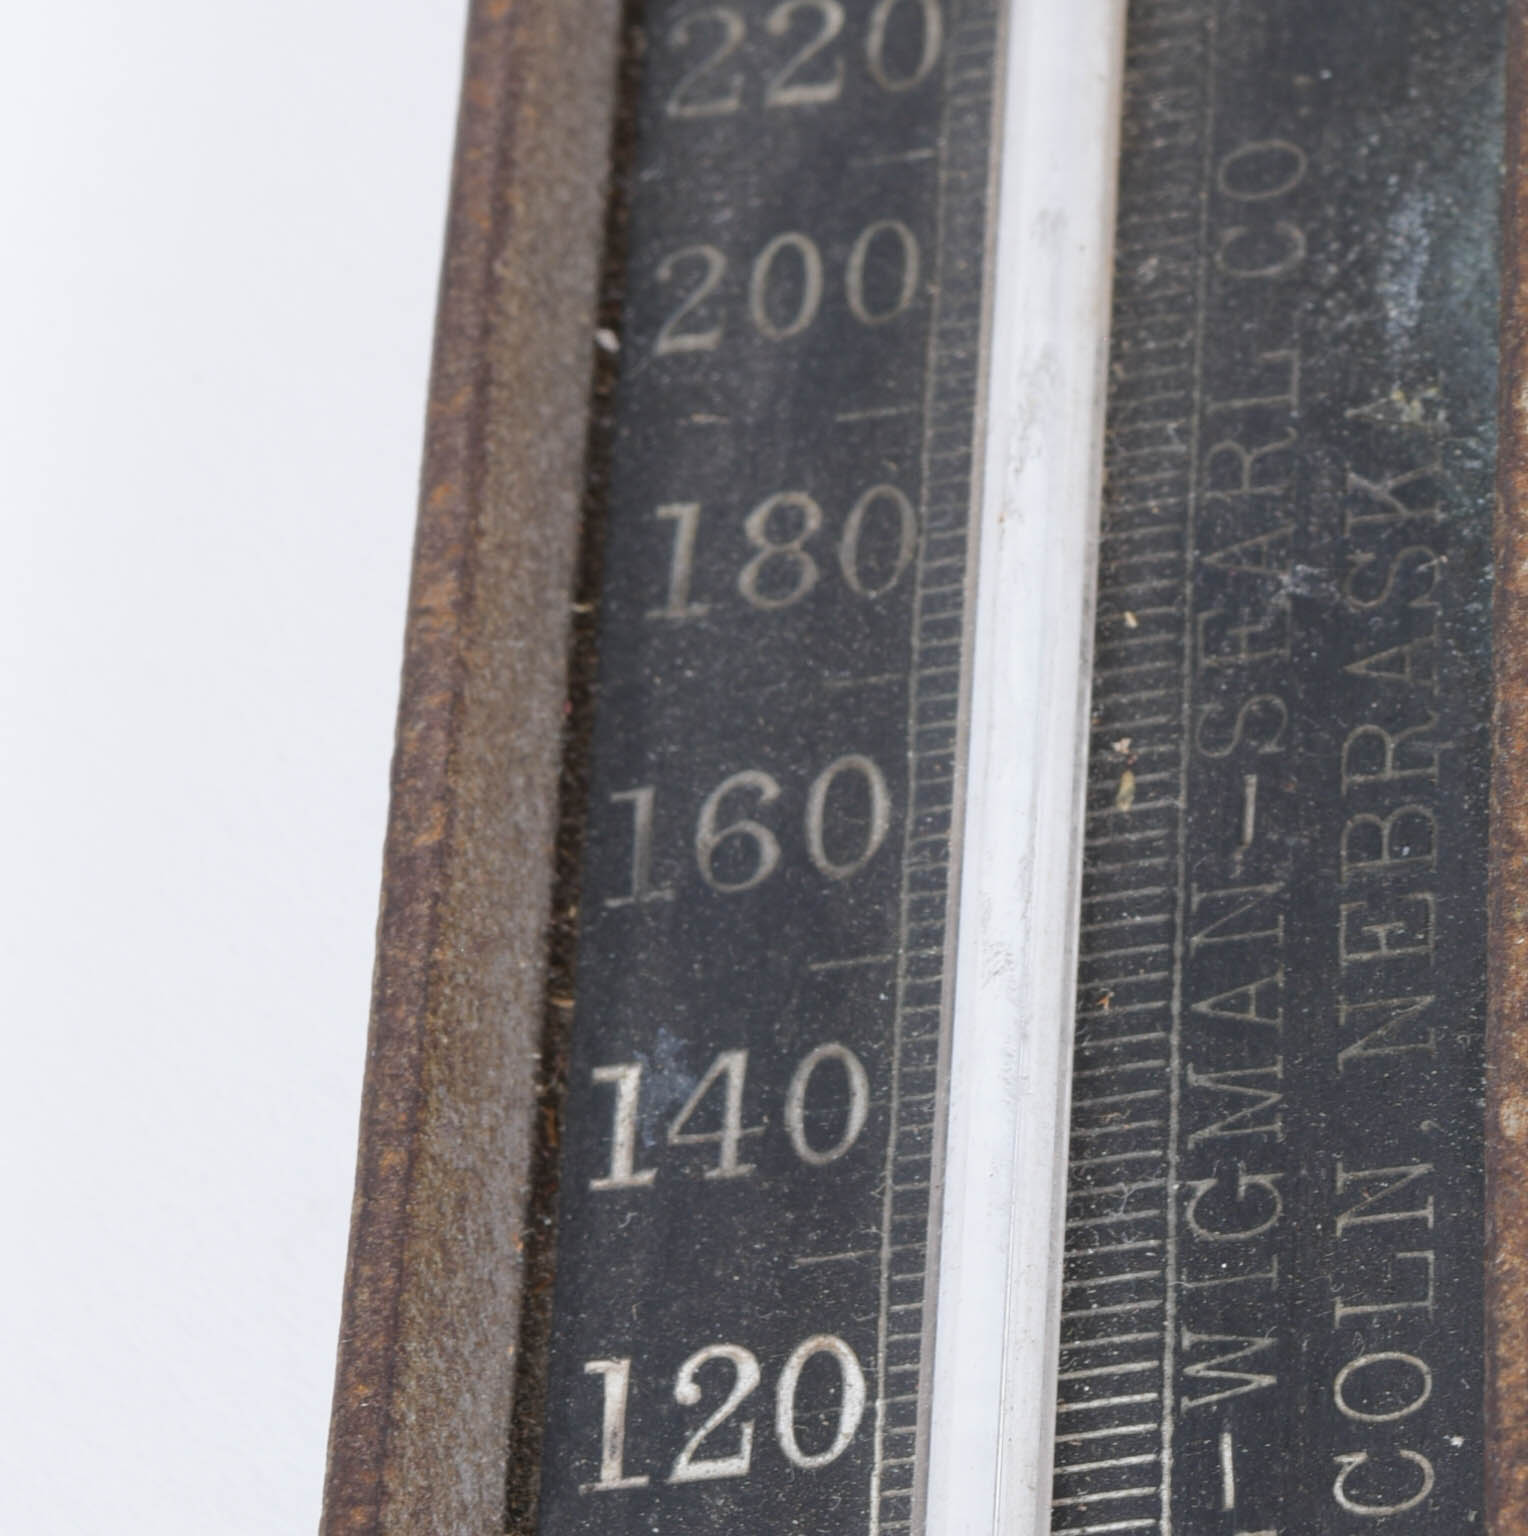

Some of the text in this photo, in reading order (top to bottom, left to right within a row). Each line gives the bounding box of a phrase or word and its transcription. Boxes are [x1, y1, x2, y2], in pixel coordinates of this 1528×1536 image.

[654, 219, 920, 356] 200
[644, 483, 919, 619] 180
[1336, 386, 1450, 1072] NEBRASKA
[603, 753, 891, 908] 160
[589, 1041, 870, 1191] 140
[578, 1333, 867, 1496] 120
